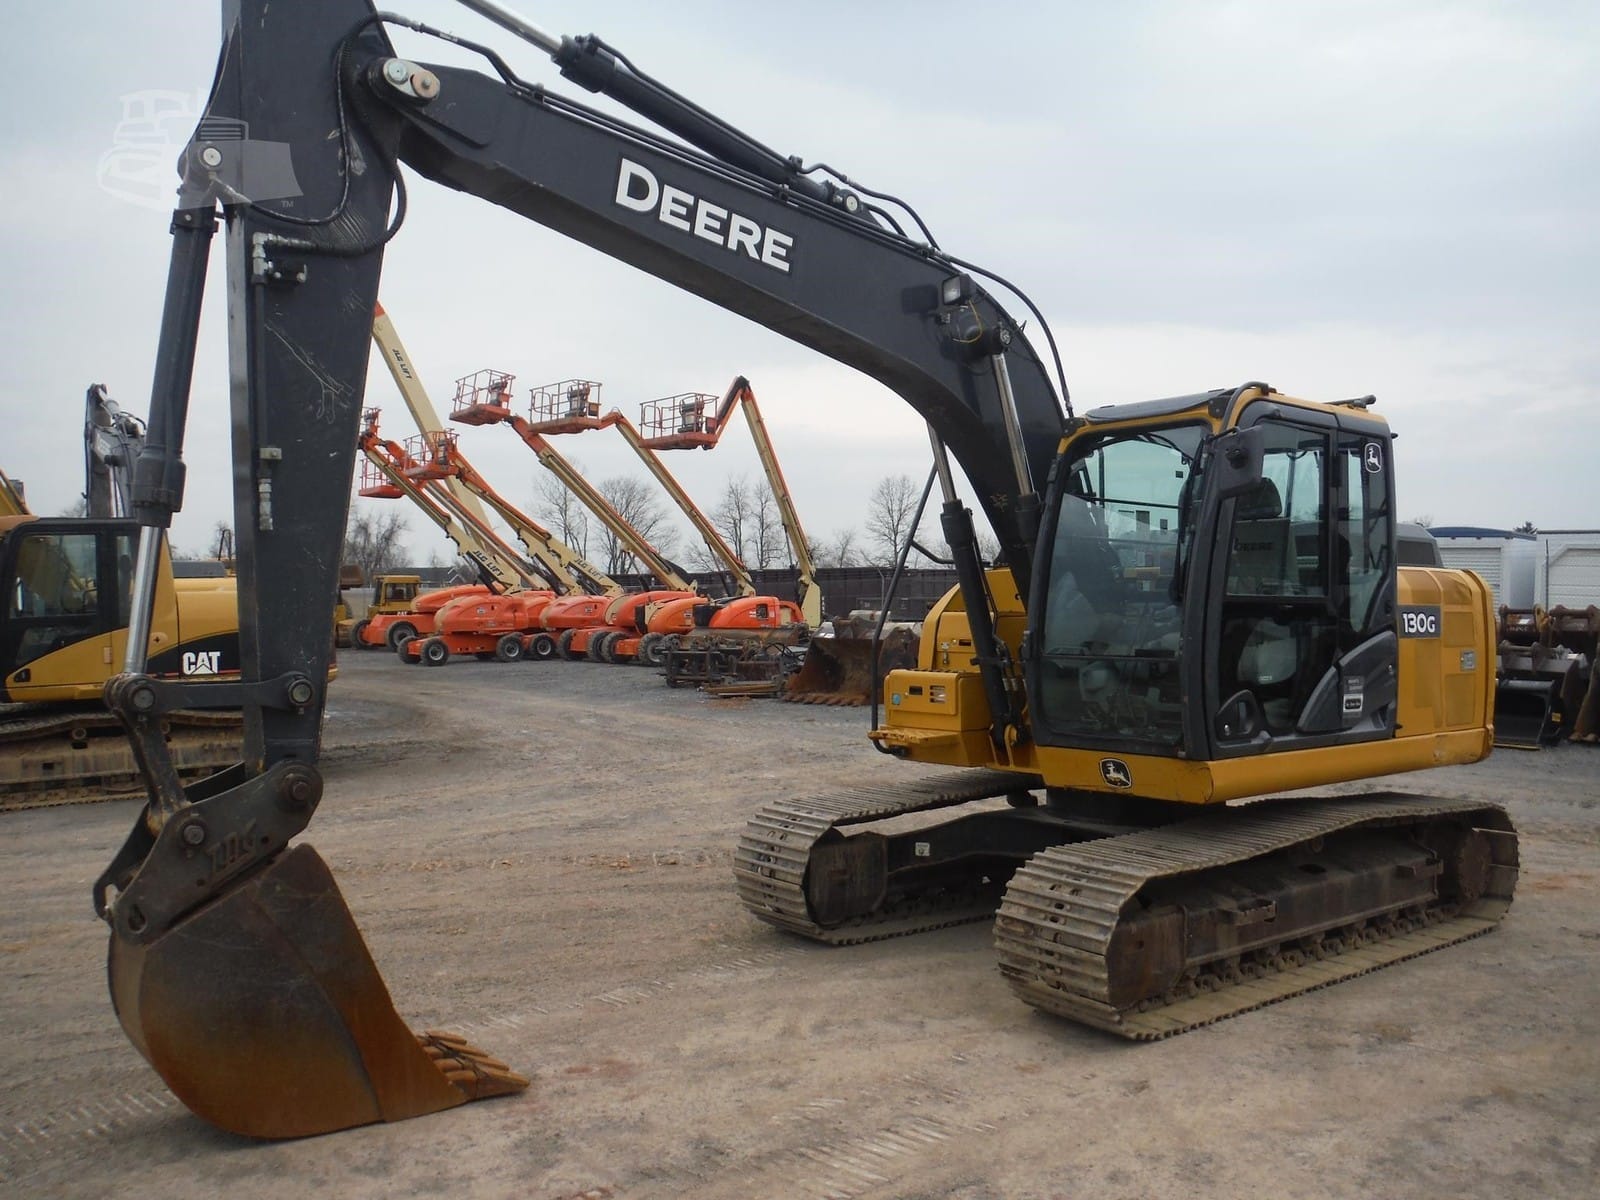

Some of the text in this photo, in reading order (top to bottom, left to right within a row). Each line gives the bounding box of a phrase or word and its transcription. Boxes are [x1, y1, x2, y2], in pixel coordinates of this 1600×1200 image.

[615, 158, 793, 272] DEERE
[400, 363, 412, 379] LIFT
[473, 550, 504, 577] JLG LIFT
[575, 559, 605, 580] JLG LIFT
[1402, 613, 1436, 633] 130G
[183, 651, 221, 675] CAT
